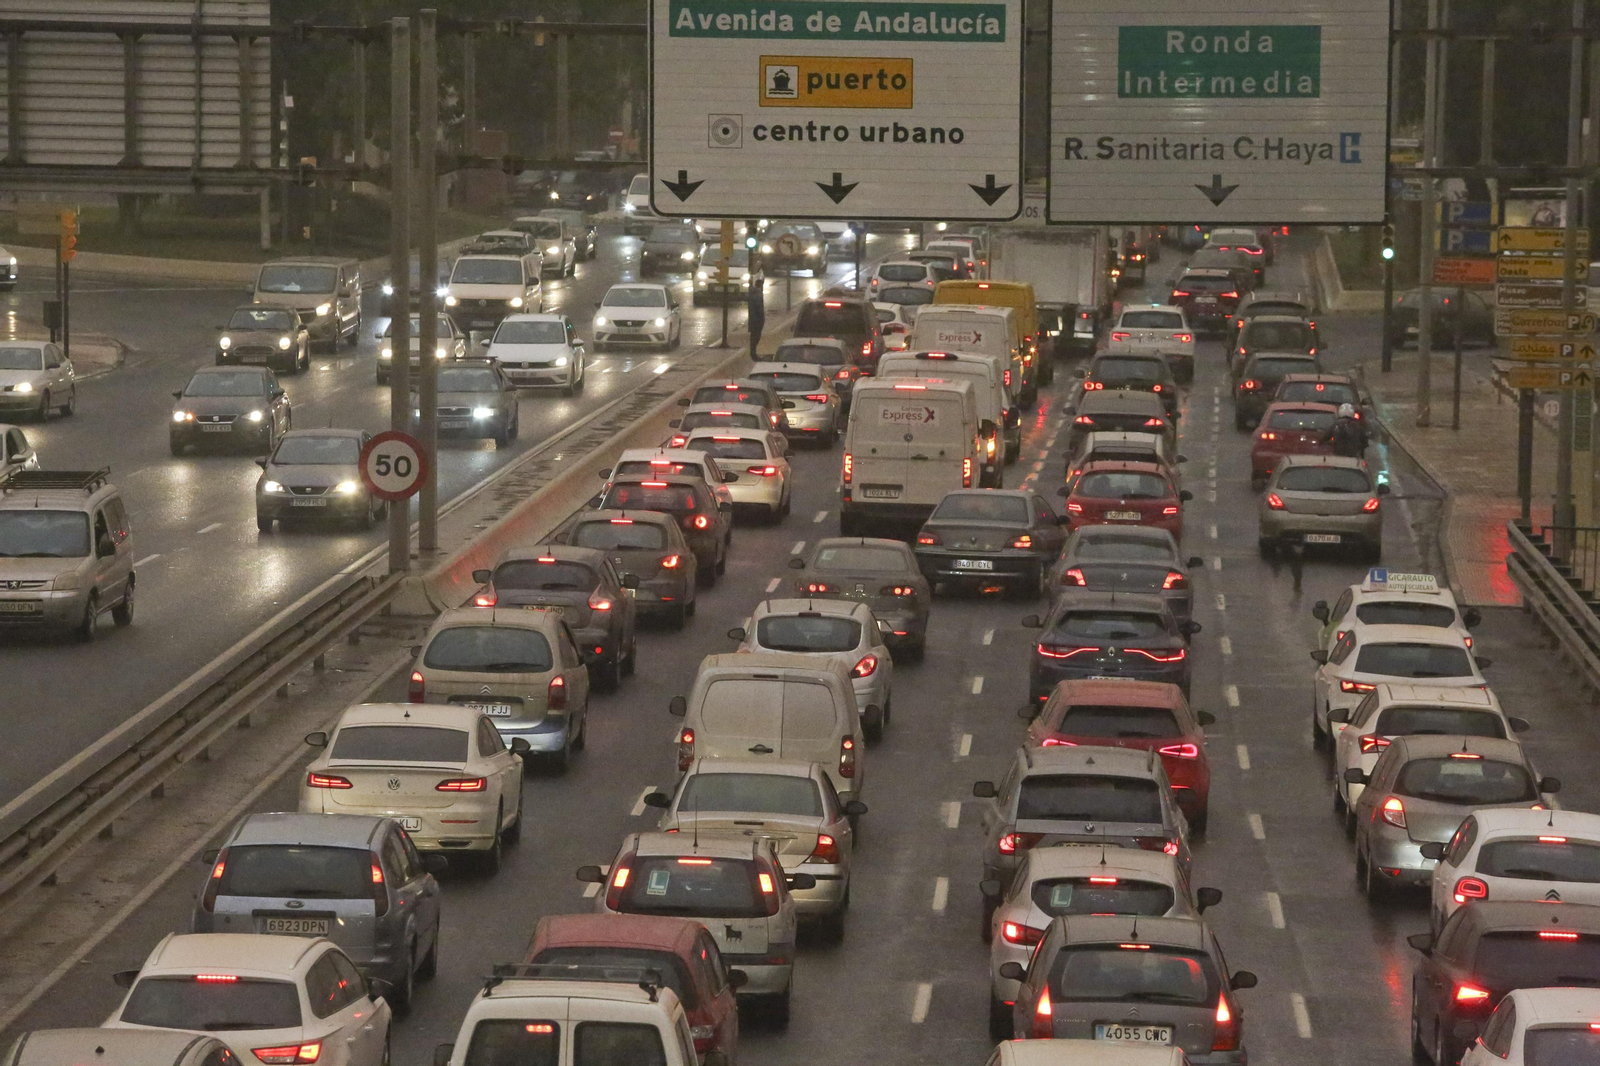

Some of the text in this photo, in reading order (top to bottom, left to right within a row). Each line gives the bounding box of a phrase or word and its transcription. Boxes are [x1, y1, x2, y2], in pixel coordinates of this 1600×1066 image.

[675, 8, 1001, 35] Avenida de Andalucía
[1166, 30, 1274, 53] Ronda
[807, 69, 907, 94] puerto
[1124, 70, 1313, 94] Intermedia
[753, 121, 965, 144] centro urbano
[1095, 136, 1225, 160] Sanitaria
[1511, 315, 1565, 327] Carrefour
[1568, 315, 1580, 329] P
[939, 333, 971, 342] Express
[1562, 345, 1572, 356] P
[1561, 372, 1571, 385] P
[882, 409, 922, 421] Express
[375, 454, 412, 477] 50
[1374, 570, 1383, 582] L
[1388, 583, 1434, 591] AUTOESCUELAS
[491, 705, 508, 714] FJJ
[399, 818, 419, 829] KLJ
[650, 872, 665, 889] L
[1053, 889, 1068, 905] L
[268, 920, 326, 932] 6923 DPN
[1105, 1027, 1168, 1041] 4055 CWC
